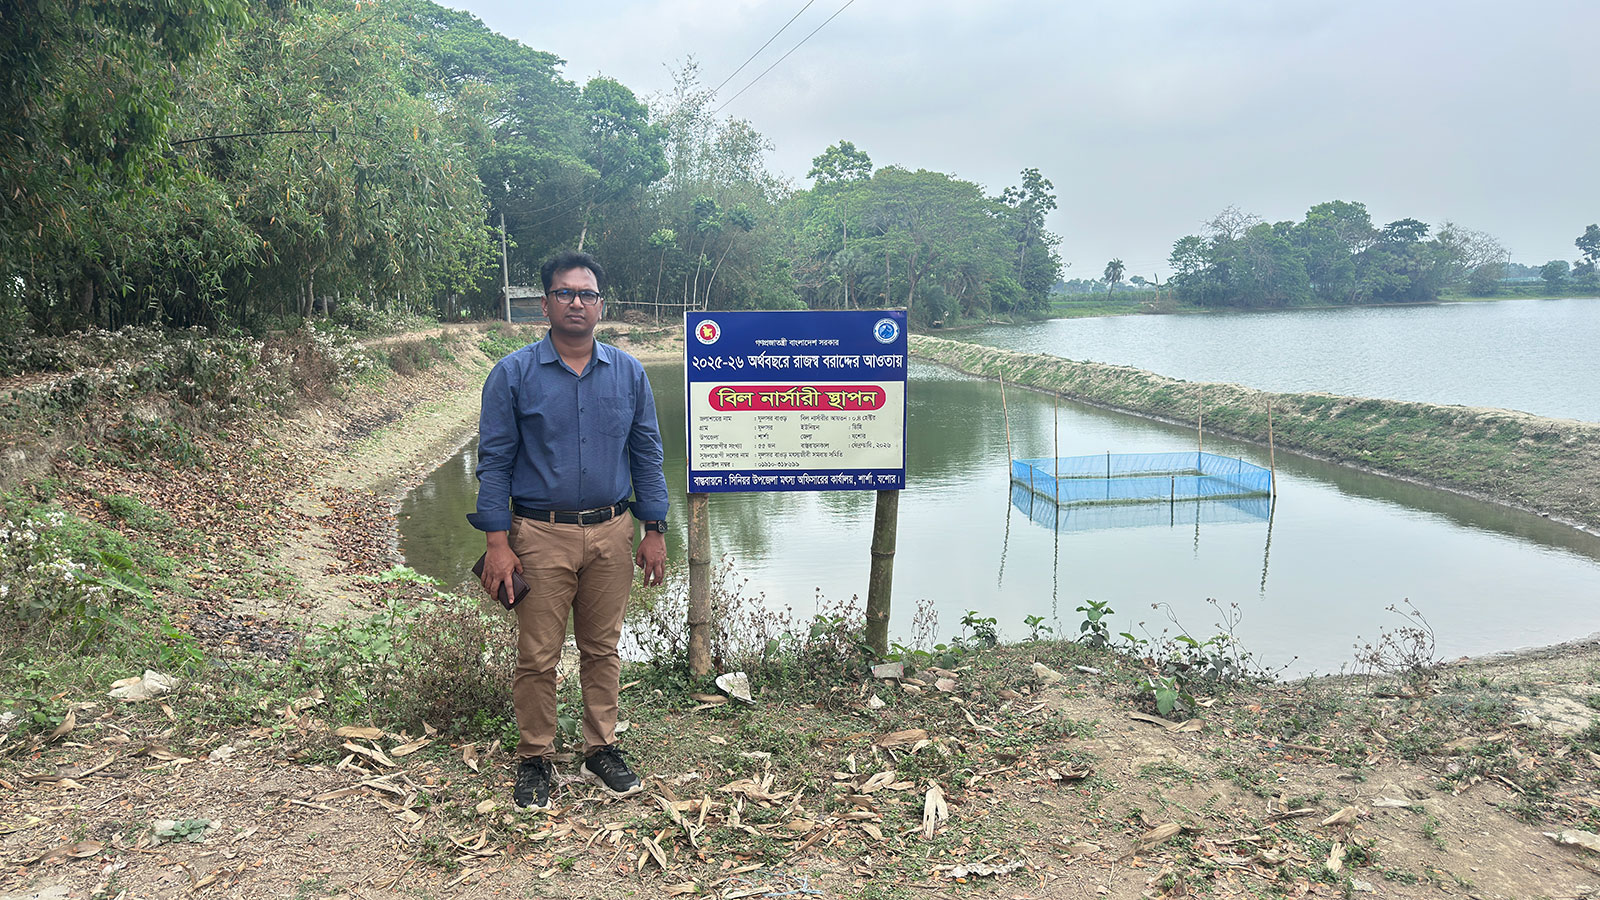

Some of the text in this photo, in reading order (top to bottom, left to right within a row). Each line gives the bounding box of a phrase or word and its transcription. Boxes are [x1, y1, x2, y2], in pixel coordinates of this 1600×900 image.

[789, 338, 817, 347] বাংলাদেশ
[818, 338, 840, 347] সরকার
[691, 350, 903, 370] ২০২৫-২৬ অর্থবছরে রাজস্ব বরাদ্দের আওতায়
[716, 386, 879, 409] বিল নার্সারী স্থাপন
[800, 414, 809, 422] বিল
[800, 423, 820, 431] ইউনিয়ন
[699, 433, 719, 441] উপজেলা
[758, 432, 769, 440] শার্শা
[693, 476, 723, 487] বাস্তবায়নে
[728, 473, 751, 486] সিনিয়র
[752, 474, 779, 486] উপজেলা
[780, 475, 796, 486] মৎস্য
[797, 473, 829, 485] অফিসারের
